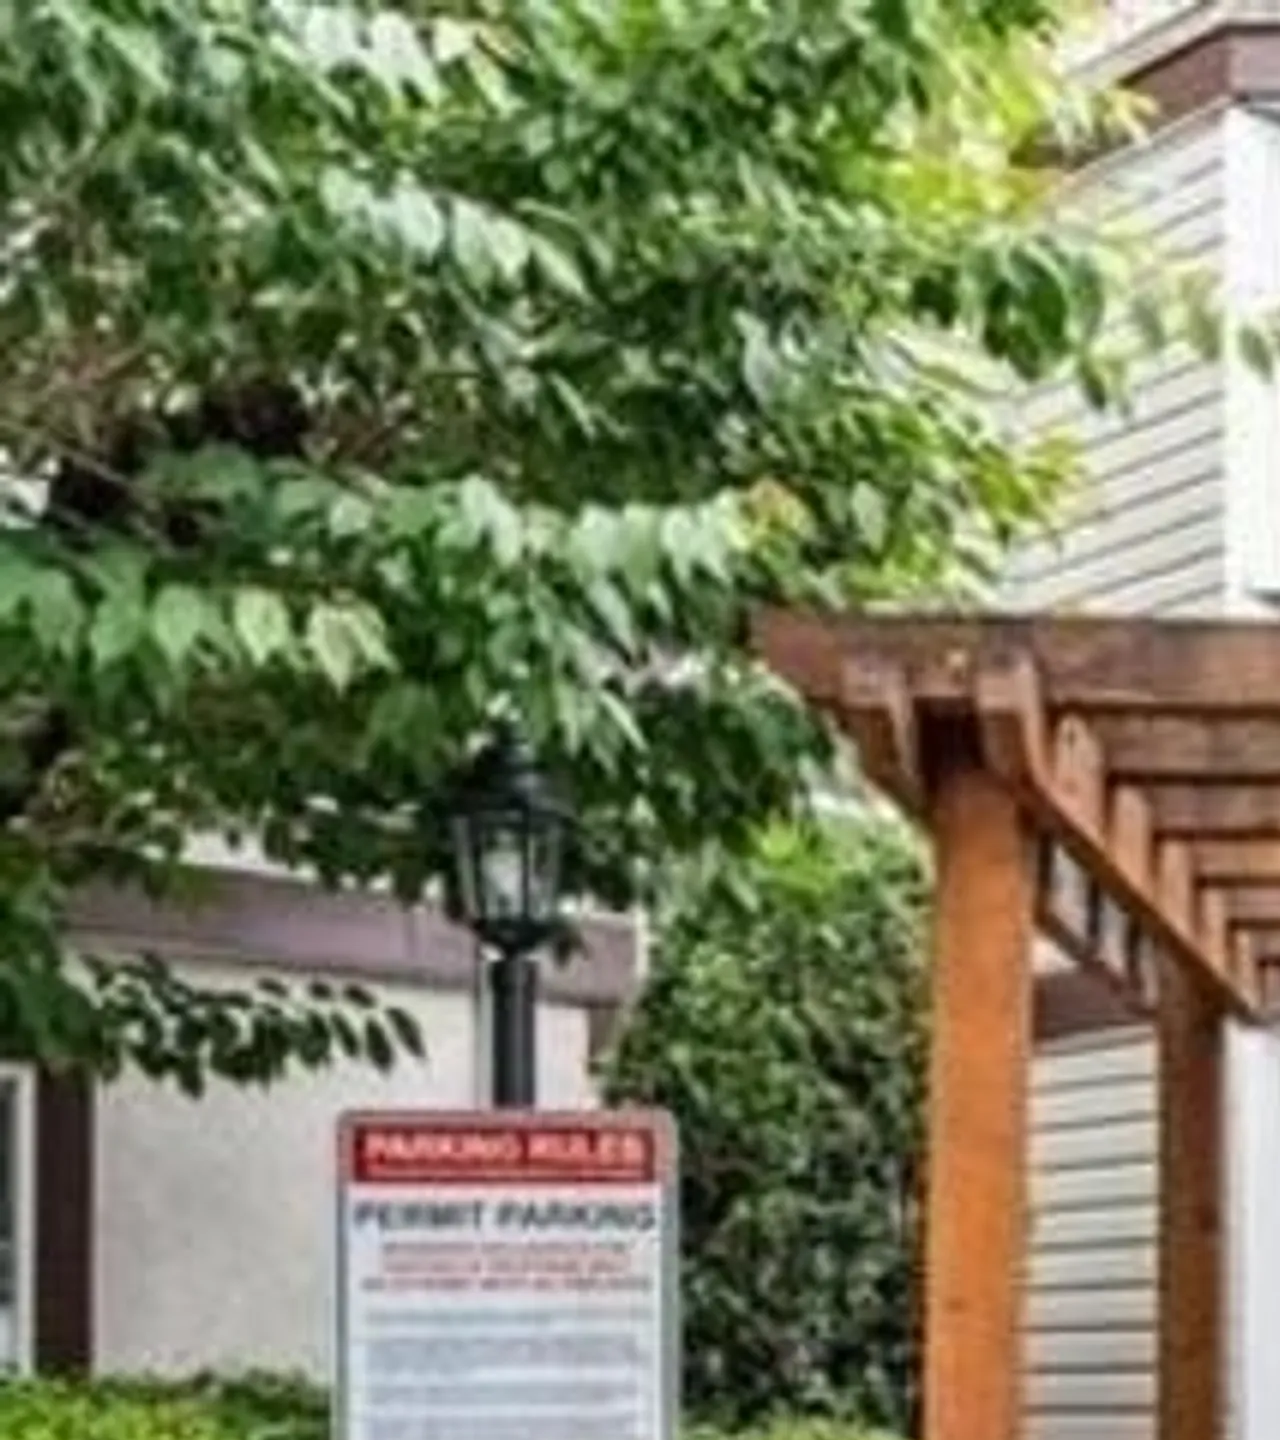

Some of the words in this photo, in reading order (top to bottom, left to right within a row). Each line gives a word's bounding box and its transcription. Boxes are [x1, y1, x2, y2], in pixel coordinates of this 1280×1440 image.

[364, 1131, 521, 1162] PARKING
[528, 1131, 645, 1162] RULES
[354, 1203, 483, 1229] PERMIT
[495, 1203, 656, 1229] PARKING
